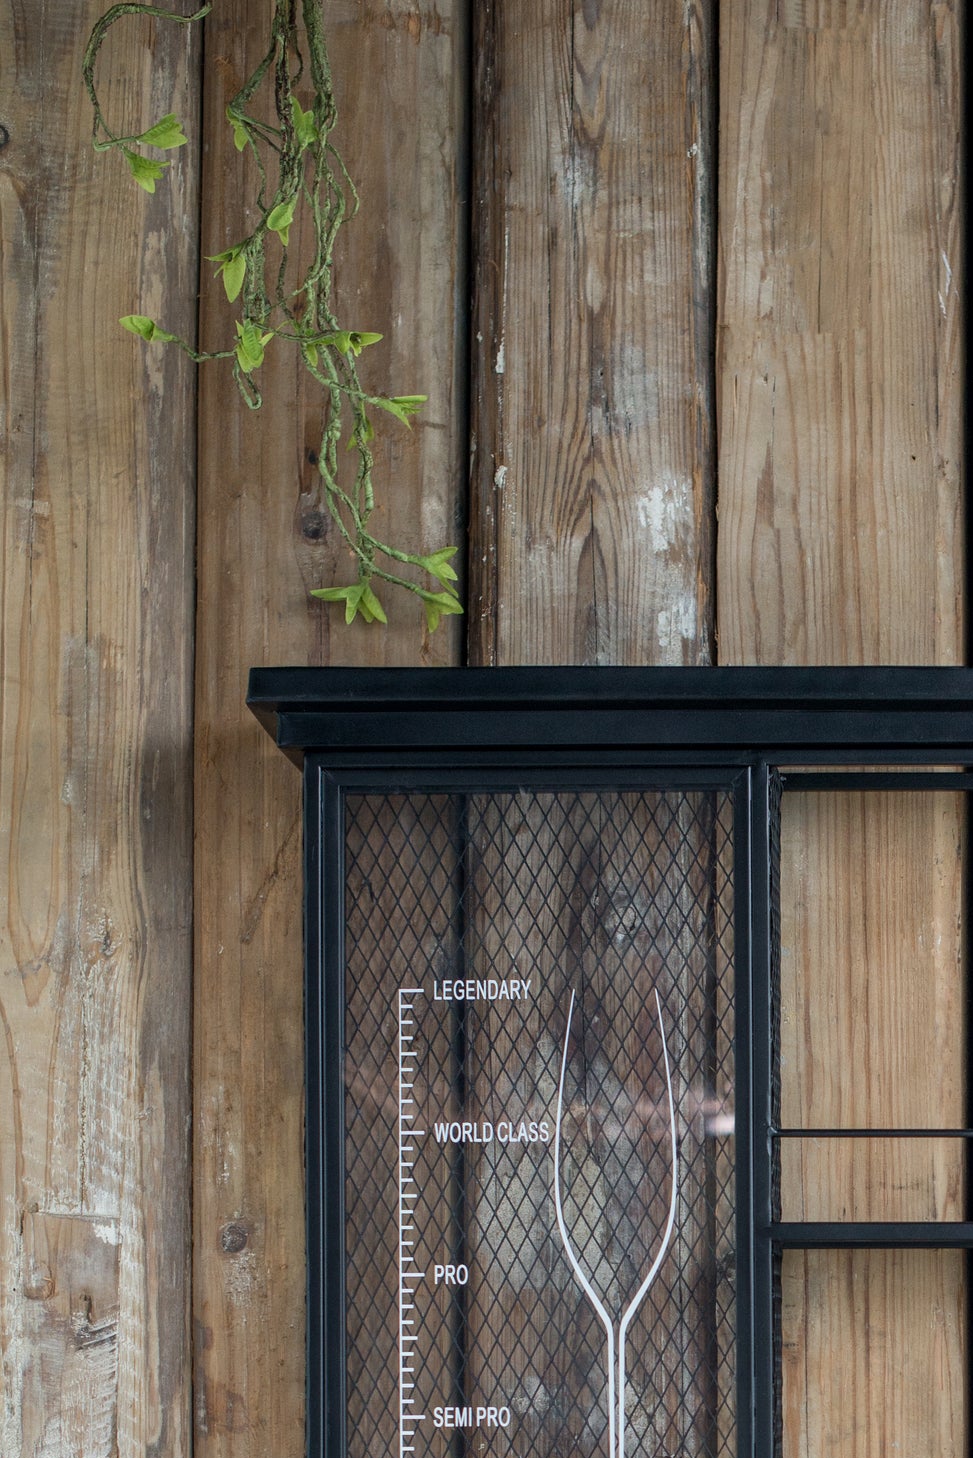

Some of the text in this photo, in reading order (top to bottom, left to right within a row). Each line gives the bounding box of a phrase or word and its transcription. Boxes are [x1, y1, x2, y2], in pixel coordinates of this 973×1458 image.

[433, 979, 532, 1001] LEGENDARY
[434, 1121, 549, 1143] WORLD CLASS
[434, 1264, 469, 1285] PRO
[433, 1406, 511, 1428] SEMI PRO
